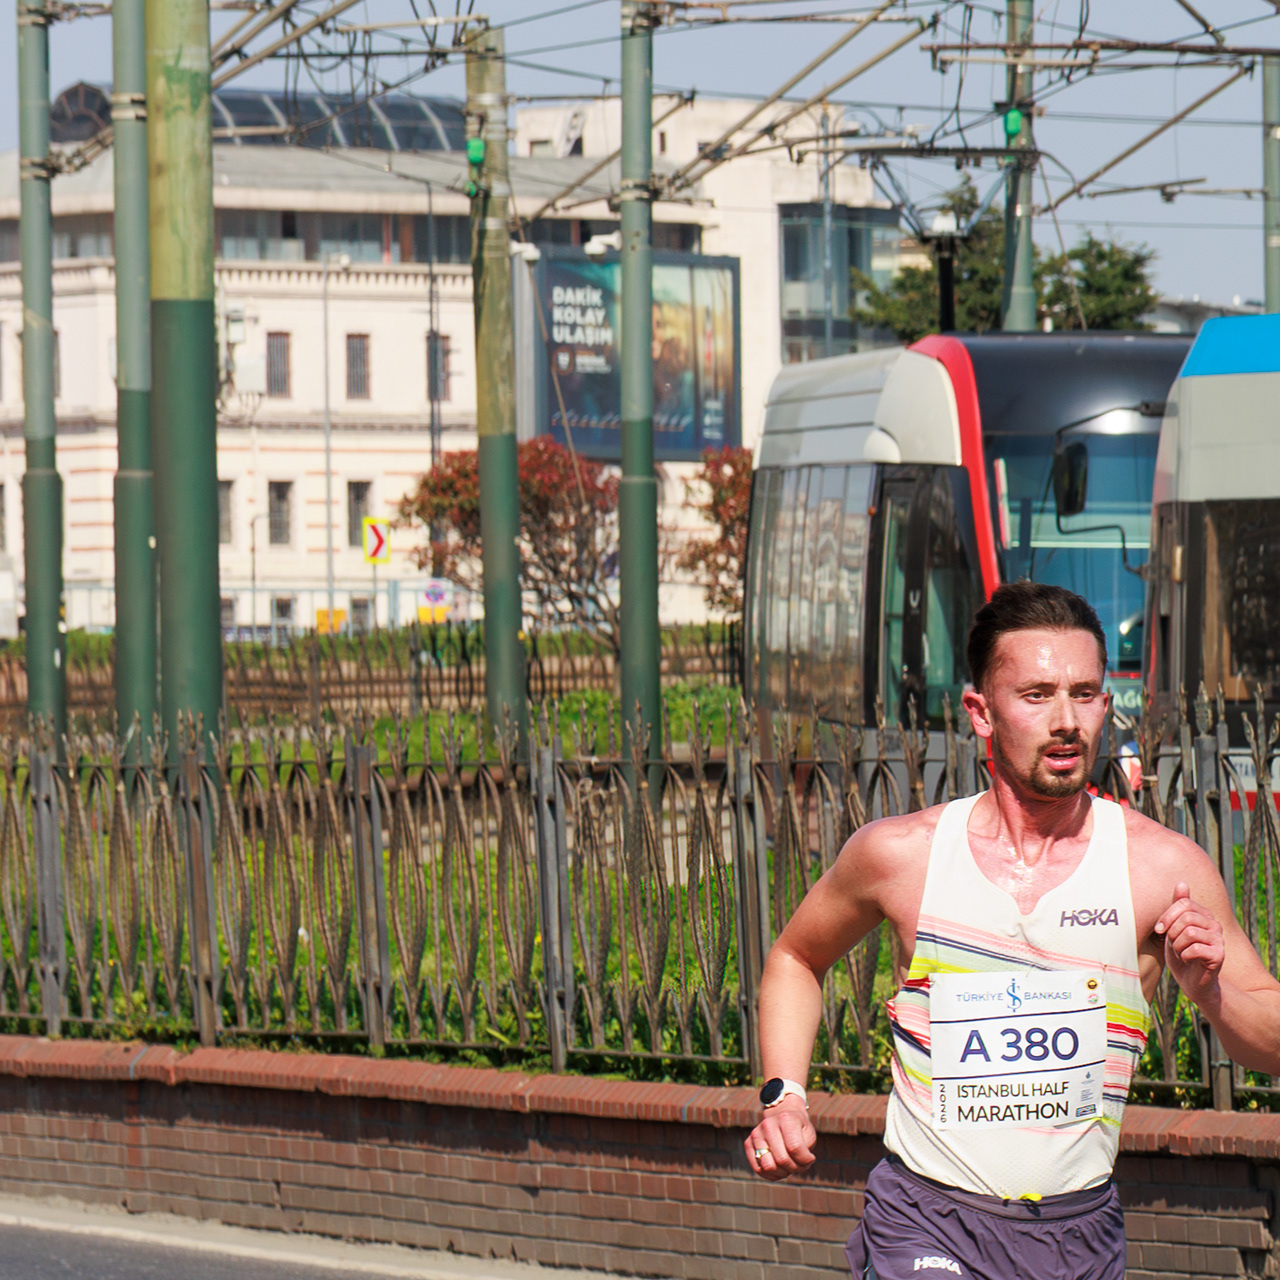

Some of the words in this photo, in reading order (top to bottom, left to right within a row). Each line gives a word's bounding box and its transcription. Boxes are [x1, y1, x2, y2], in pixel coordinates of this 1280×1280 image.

[553, 306, 606, 325] KOLAY
[553, 325, 613, 347] ULAŞIM
[1060, 908, 1119, 927] HOKA
[1024, 992, 1072, 1000] BANKASI
[960, 1030, 992, 1062] A
[1000, 1027, 1079, 1061] 380
[957, 1083, 1029, 1098] ISTANBUL
[1032, 1081, 1070, 1097] HALF
[957, 1100, 1069, 1122] MARATHON
[913, 1256, 962, 1275] HOKA
